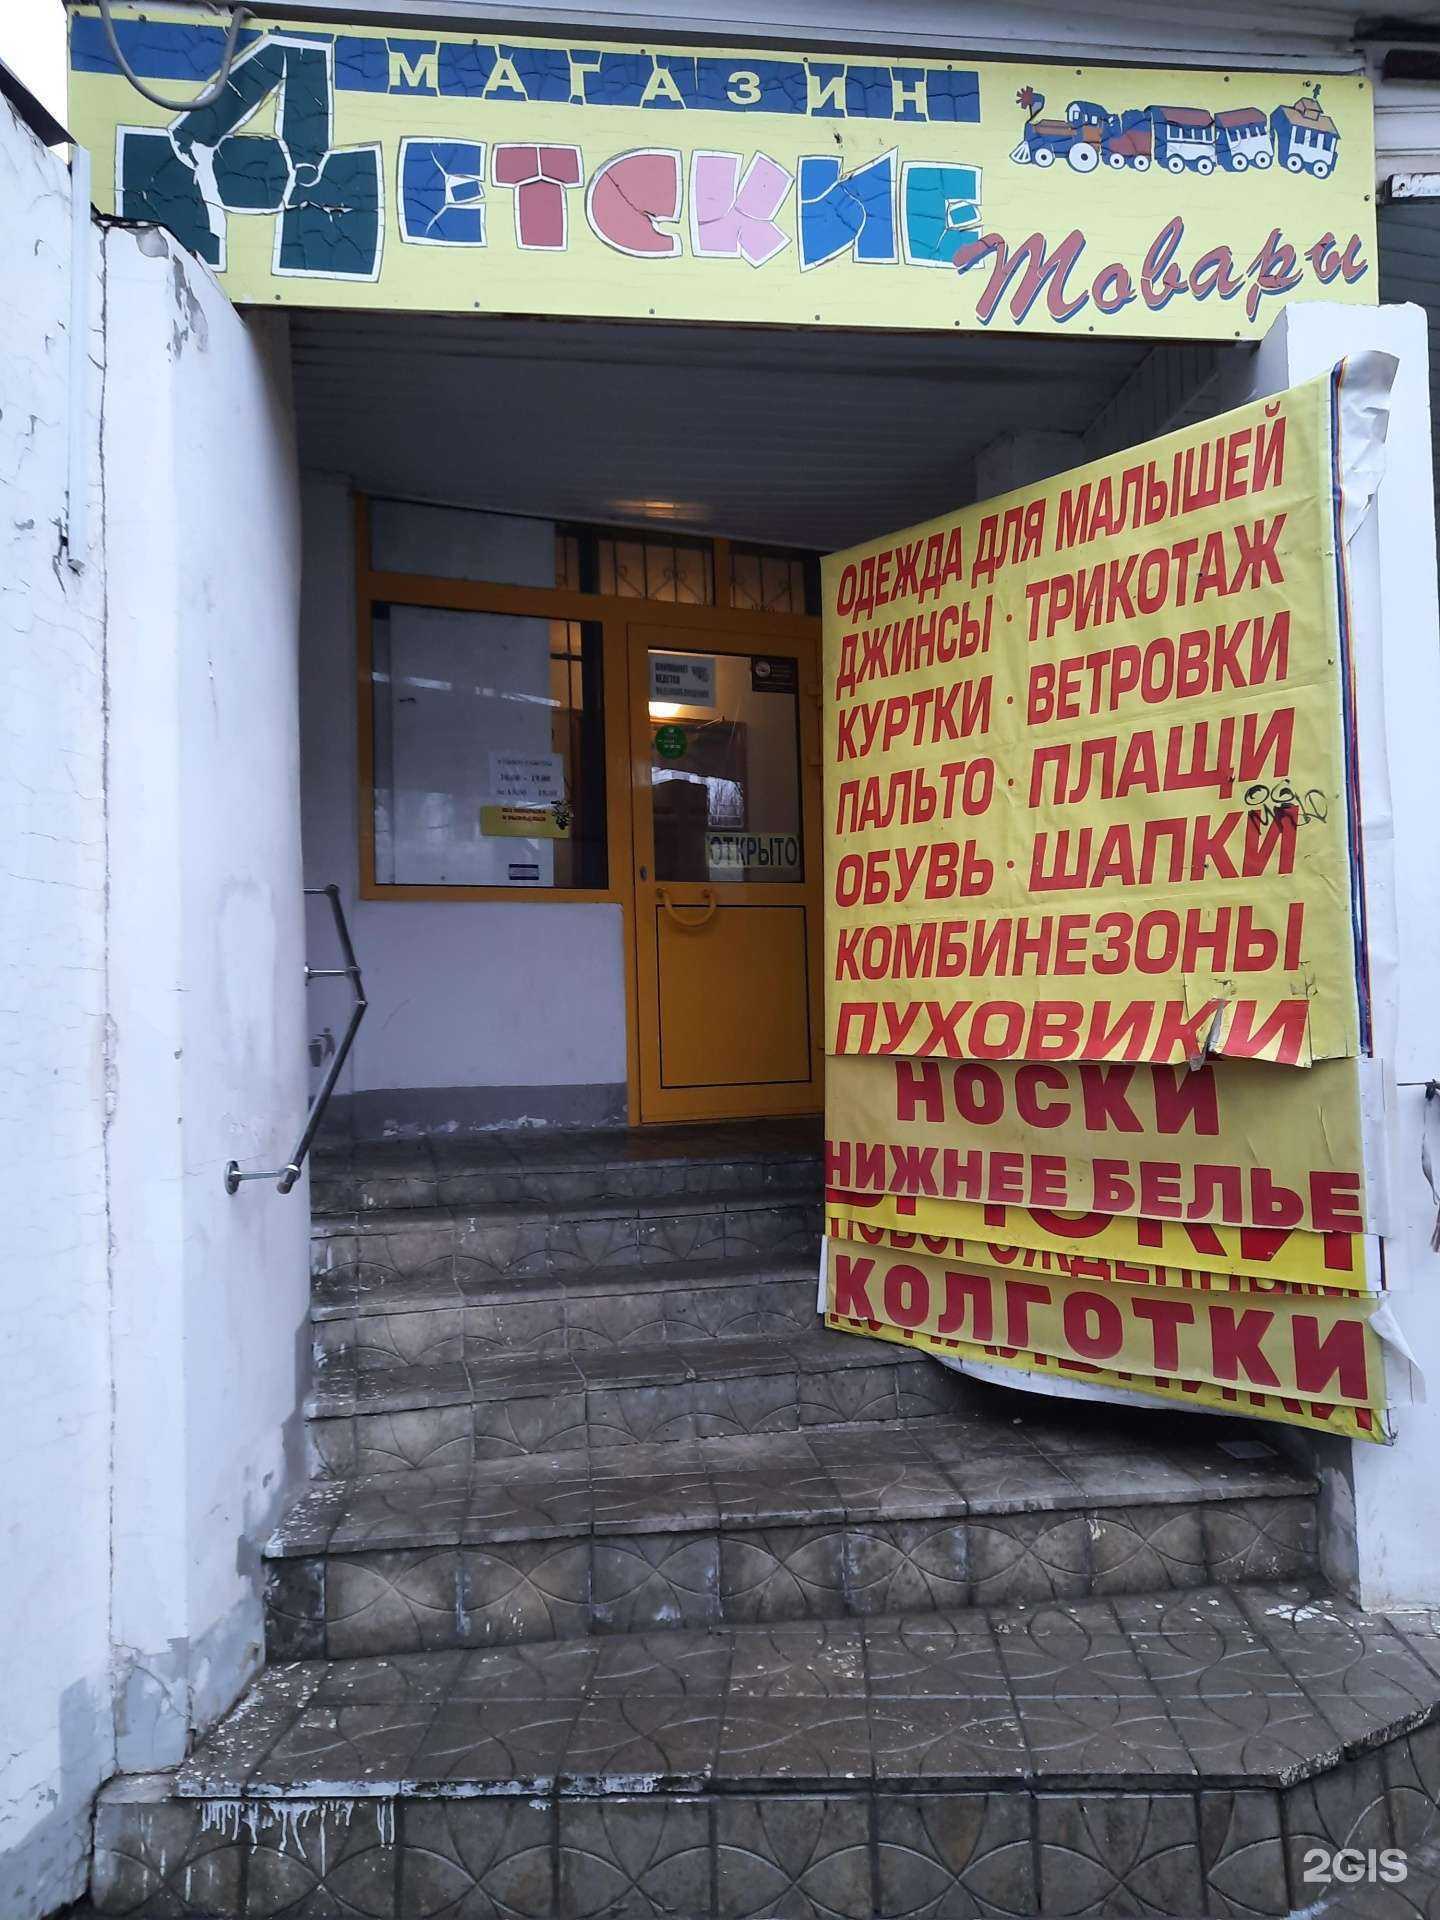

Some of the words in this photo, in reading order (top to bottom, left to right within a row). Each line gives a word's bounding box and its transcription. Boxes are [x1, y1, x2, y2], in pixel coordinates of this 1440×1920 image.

[388, 50, 928, 118] МАГАЗИН
[836, 526, 963, 624] ОДЕЖДА
[971, 498, 1046, 588] ДЛЯ
[1055, 400, 1287, 551] МАЛЫШЕЙ
[836, 596, 993, 699] ДЖИНСЫ
[1025, 513, 1286, 641] ТРИКОТАЖ
[837, 675, 993, 762] КУРТКИ
[1027, 610, 1291, 726] ВЕТРОВКИ
[836, 757, 995, 835] ПАЛЬТО
[1029, 707, 1295, 808] ПЛАЩИ
[711, 835, 799, 866] ОТКРЫТО
[836, 839, 994, 908] ОБУВЬ
[1028, 804, 1299, 892] ШАПКИ
[835, 902, 1305, 981] КОМБИНЕЗОНЫ
[835, 998, 1311, 1066] ПУХОВИКИ
[895, 1060, 1219, 1136] НОСКИ
[824, 1139, 1069, 1209] НИЖНЕЕ
[1092, 1158, 1363, 1233] БЕЛЬЕ
[835, 1254, 1370, 1401] КОЛГОТКИ
